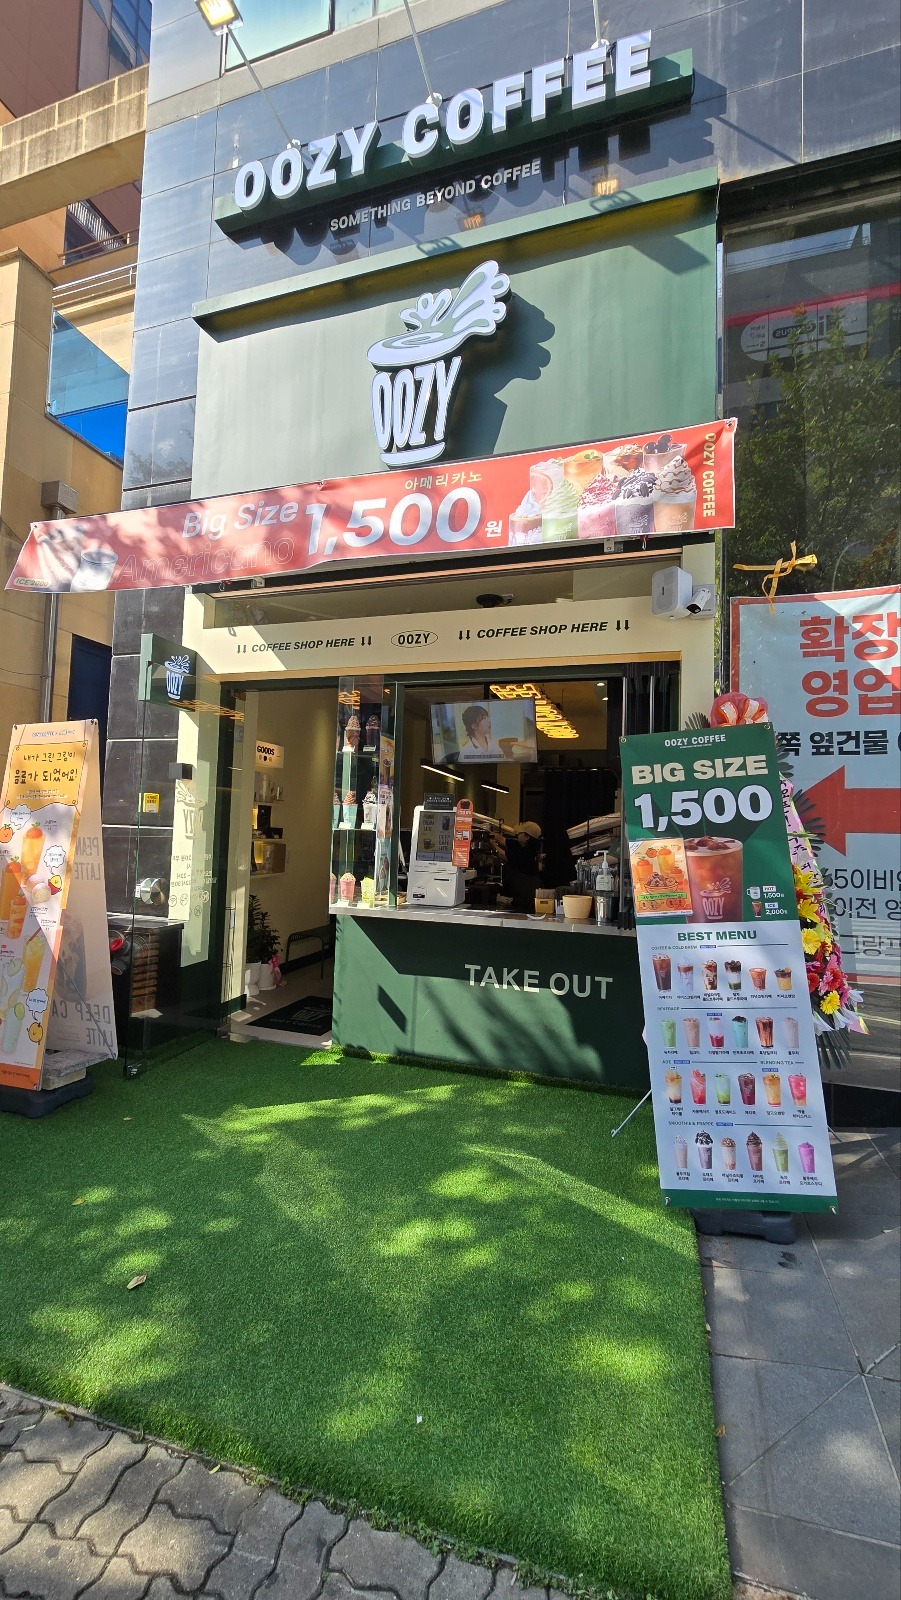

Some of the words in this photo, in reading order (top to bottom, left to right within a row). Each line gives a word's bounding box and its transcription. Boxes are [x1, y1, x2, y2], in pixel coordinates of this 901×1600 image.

[234, 120, 379, 210] OOZY
[402, 30, 651, 158] COFFEE
[330, 196, 411, 231] SOMETHING
[416, 179, 476, 207] BEYOND
[481, 159, 541, 189] COFFEE
[372, 356, 462, 449] OOZY
[703, 433, 716, 467] OOZY
[405, 471, 482, 490] 아메리카노
[703, 470, 716, 518] COFFEE
[182, 512, 227, 541] Big
[234, 501, 299, 530] Size
[306, 486, 482, 556] 1,500
[485, 520, 502, 538] 원
[115, 537, 294, 583] Americano
[398, 633, 430, 645] OOZY
[477, 626, 527, 639] COFFEE
[530, 624, 567, 636] SHOP
[570, 621, 608, 633] HERE
[252, 642, 291, 653] COFFEE
[294, 640, 323, 650] SHOP
[325, 638, 355, 648] HERE
[166, 671, 185, 694] OOZY
[801, 666, 901, 718] 영업
[257, 745, 275, 755] GOODS
[665, 738, 688, 747] OOZY
[692, 734, 726, 744] COFFEE
[810, 730, 889, 756] 옆건물
[24, 753, 39, 762] 내가
[42, 752, 55, 762] 그린
[56, 751, 76, 762] 그림이
[14, 769, 39, 784] 음료가
[632, 763, 685, 785] BIG
[693, 755, 769, 780] SIZE
[634, 784, 773, 832] 1,500
[702, 898, 725, 915] OOZY
[834, 897, 877, 919] 이전
[678, 931, 713, 941] BEST
[715, 930, 757, 940] MENU
[465, 964, 540, 993] TAKE
[550, 972, 613, 1000] OUT
